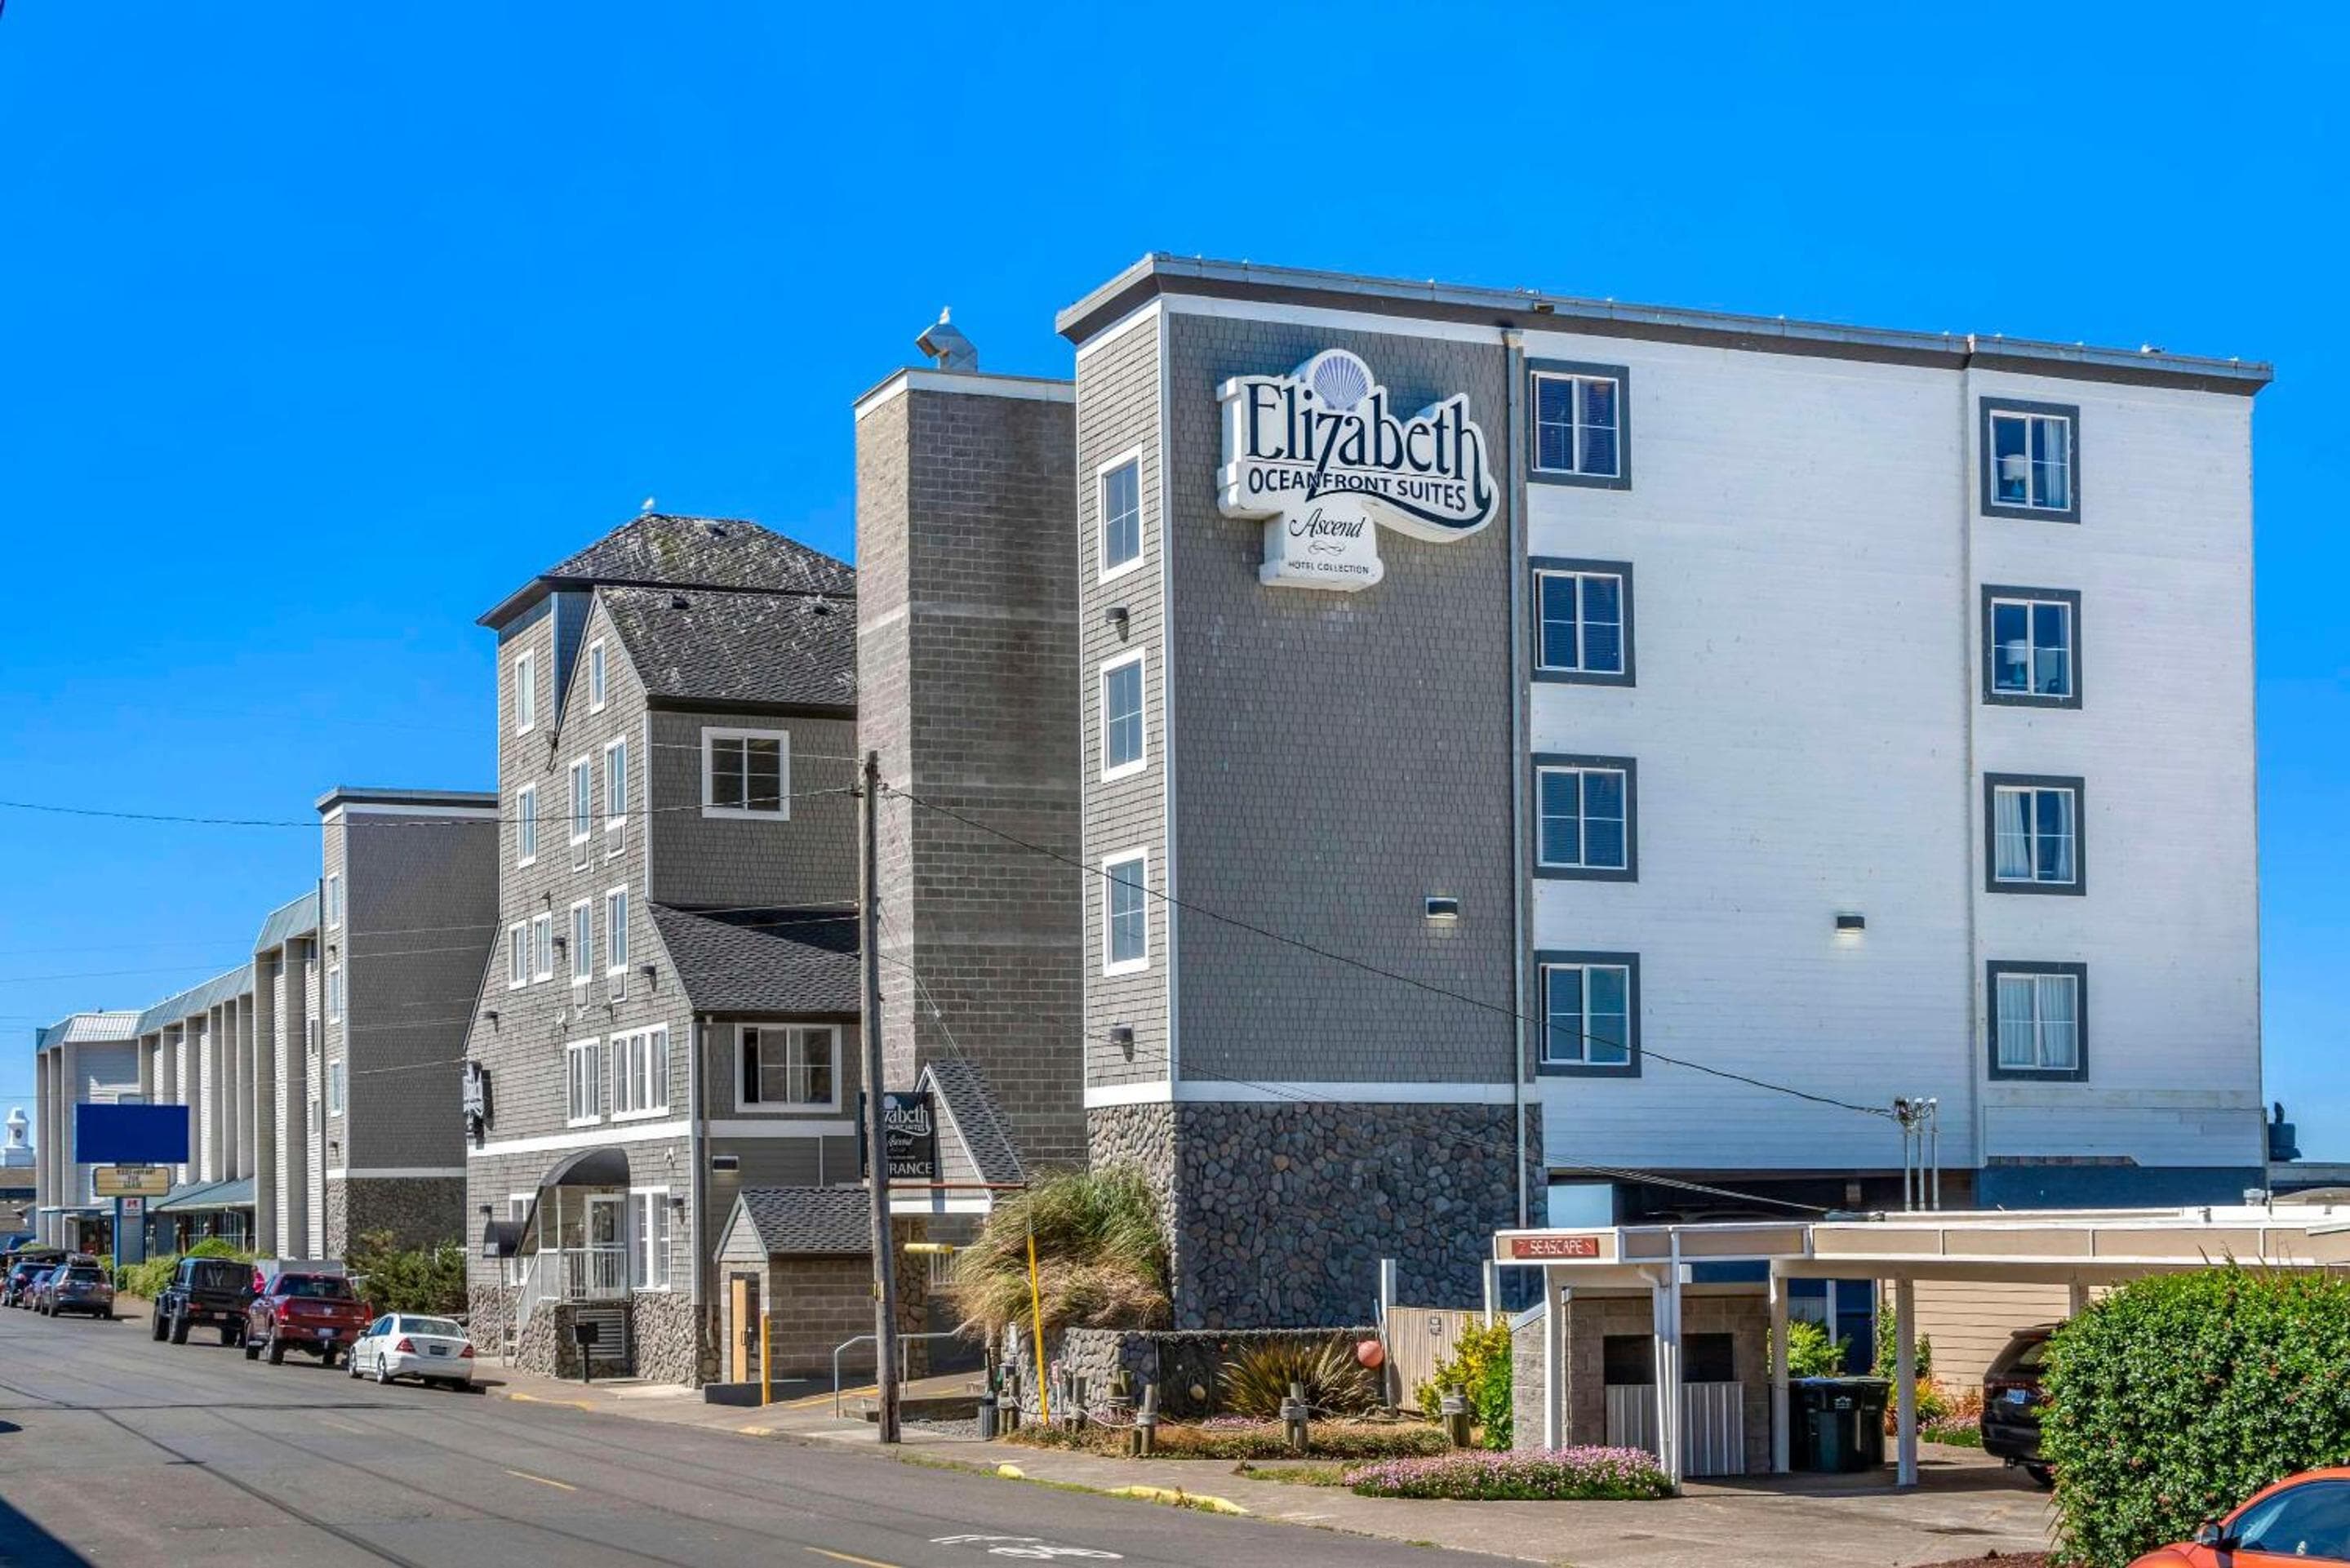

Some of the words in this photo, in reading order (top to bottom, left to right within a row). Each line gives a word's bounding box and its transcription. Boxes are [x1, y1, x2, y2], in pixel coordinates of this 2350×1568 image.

[1244, 383, 1491, 510] Elizabeth
[1248, 468, 1391, 495] OCEANFRONT
[1397, 480, 1467, 512] SUITES
[1289, 507, 1365, 539] Ascend
[1289, 561, 1314, 570] HOTEL
[1317, 563, 1370, 575] COLLECTION
[864, 1162, 933, 1175] ERANCE
[1530, 1239, 1584, 1255] SEASCAPE
